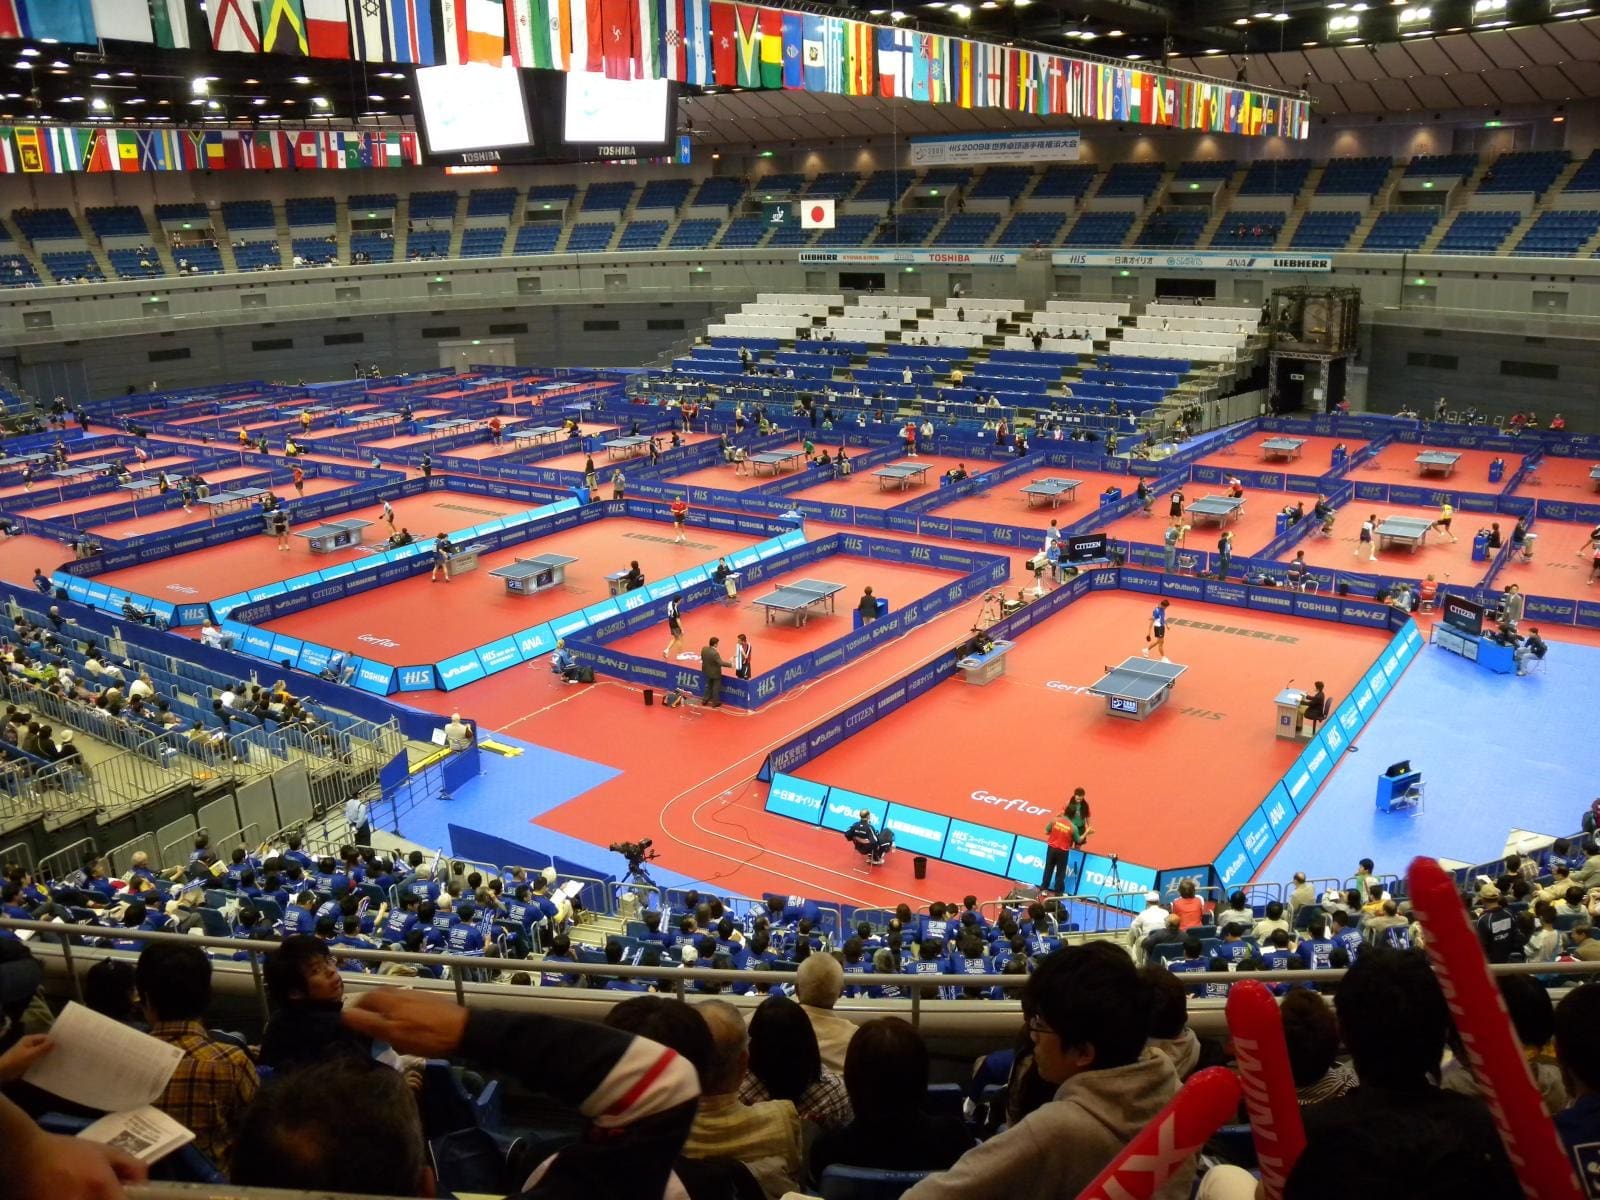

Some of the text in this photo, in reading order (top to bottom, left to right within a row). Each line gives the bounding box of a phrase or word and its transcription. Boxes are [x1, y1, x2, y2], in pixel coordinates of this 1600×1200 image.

[462, 150, 500, 162] TOSHIBA
[598, 146, 636, 156] TOSHIBA
[929, 254, 970, 263] TOSHIBA
[1226, 259, 1246, 267] ANA
[1273, 259, 1328, 268] LIEBHERR
[429, 478, 446, 488] HIS
[694, 489, 708, 500] HIS
[606, 503, 625, 513] HIS
[830, 507, 847, 519] HIS
[738, 520, 764, 530] TOSHIBA
[991, 527, 1012, 540] HIS
[844, 537, 864, 550] HIS
[1074, 541, 1102, 550] CITIZEN
[910, 546, 931, 560] HIS
[746, 565, 763, 582] HIS
[991, 562, 1006, 579] HIS
[1094, 572, 1117, 585] HIS
[311, 583, 343, 600] CITIZEN
[949, 583, 964, 600] HIS
[1175, 583, 1200, 593] Butterfly
[181, 607, 205, 620] HIS
[1296, 600, 1338, 614] TOSHIBA
[1343, 607, 1387, 621] SAN-EI
[1450, 603, 1476, 620] CITIZEN
[903, 606, 919, 626] HIS
[357, 633, 400, 648] Gerflor
[522, 635, 543, 652] ANA
[845, 633, 871, 653] TOSHIBA
[360, 669, 389, 685] TOSHIBA
[403, 671, 430, 685] HIS
[675, 671, 700, 688] HIS
[757, 674, 776, 697] HIS
[846, 704, 875, 728] CITIZEN
[971, 789, 1051, 816] Gerflor
[1086, 871, 1147, 892] TOSHIBA
[1233, 1037, 1278, 1142] WIN
